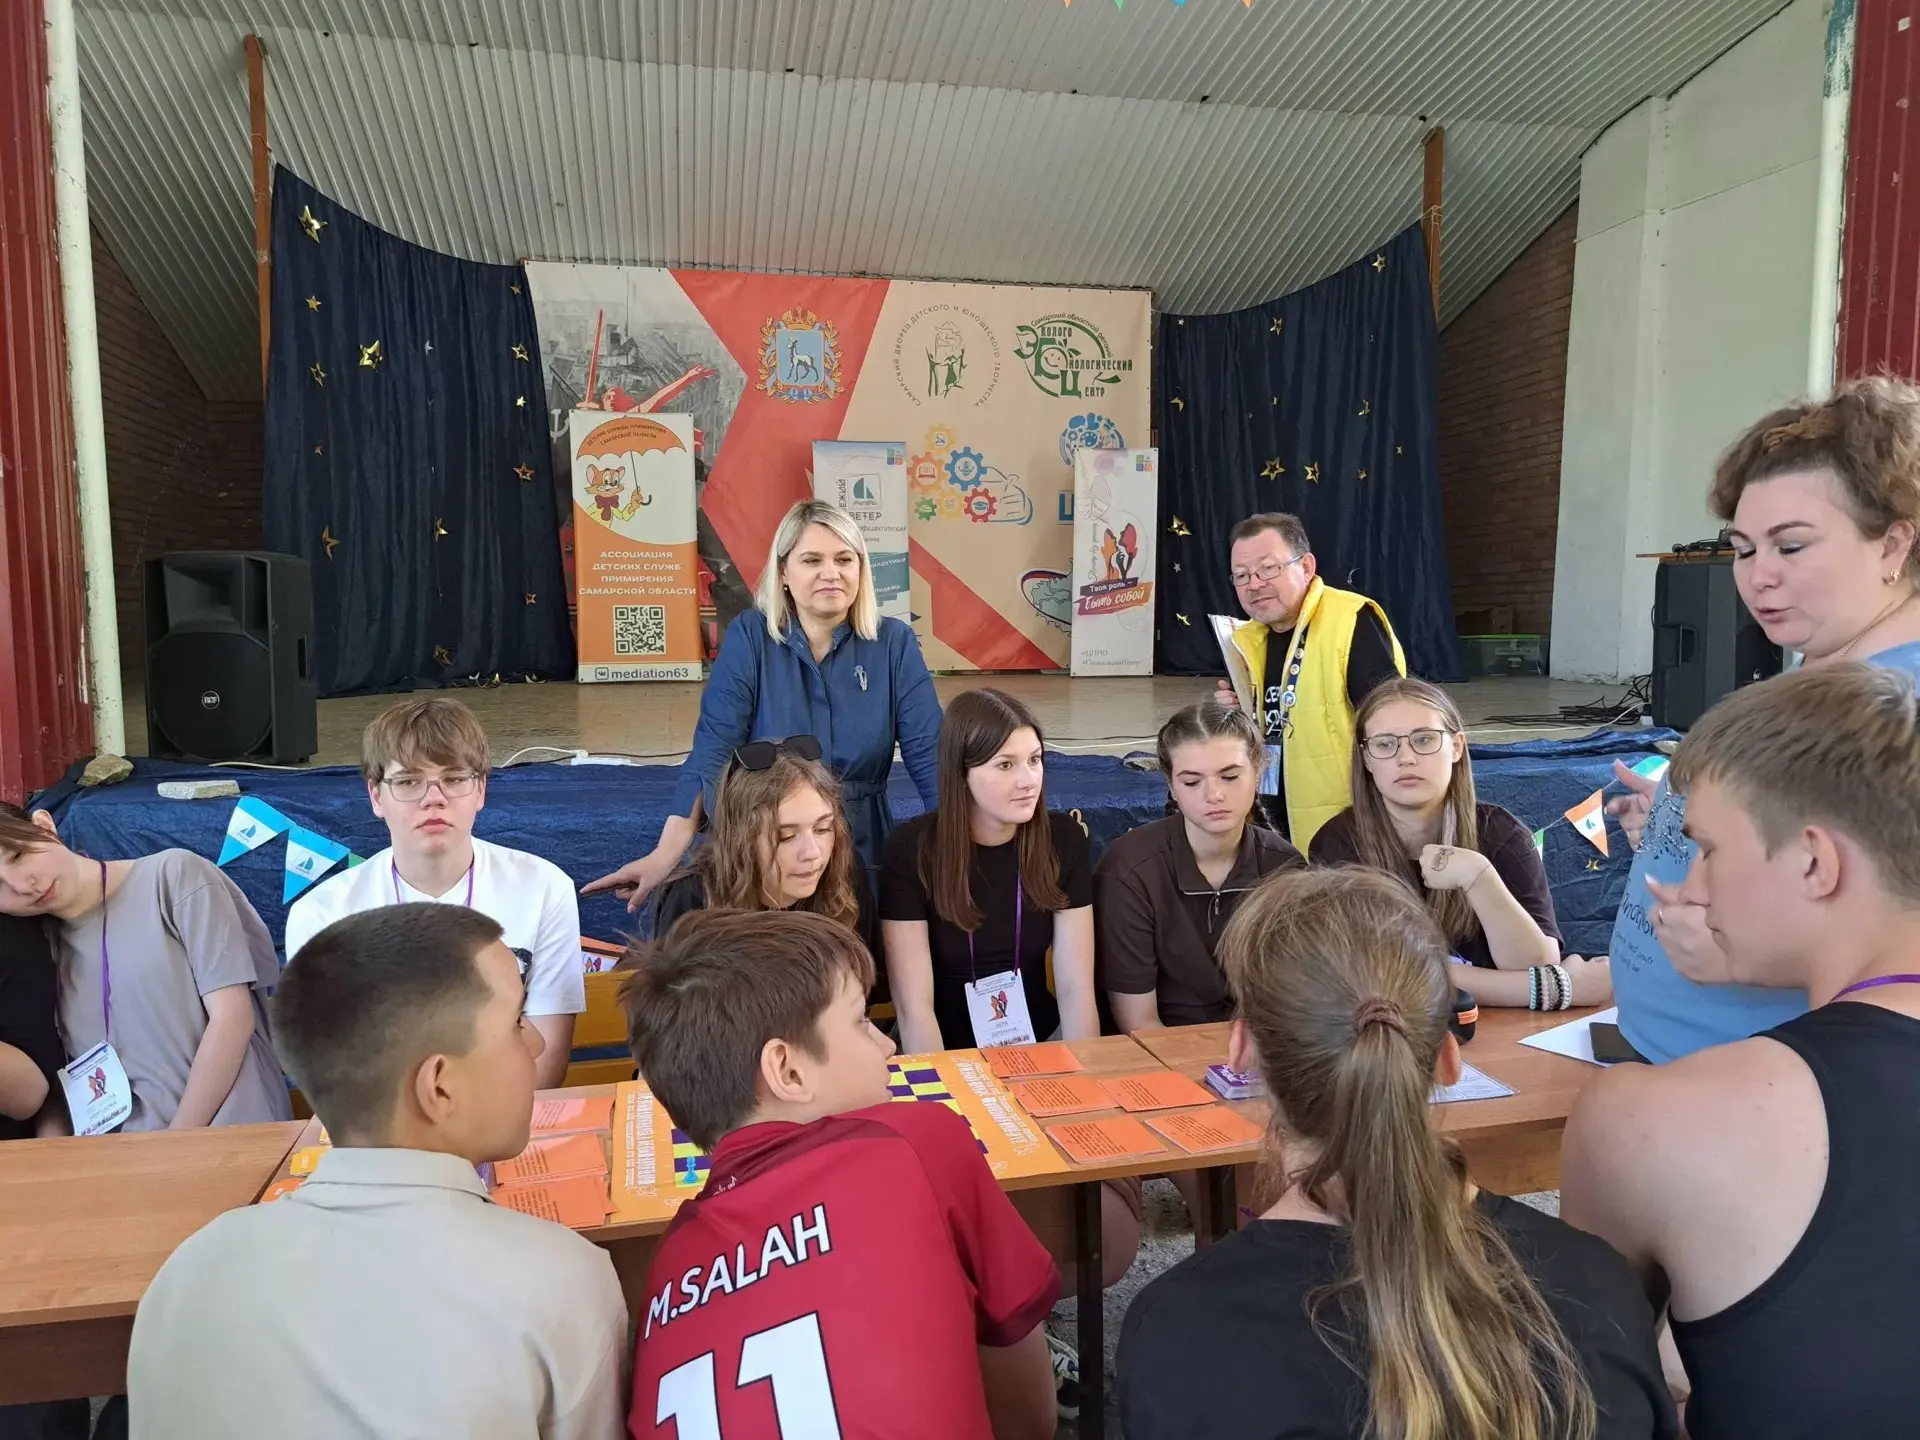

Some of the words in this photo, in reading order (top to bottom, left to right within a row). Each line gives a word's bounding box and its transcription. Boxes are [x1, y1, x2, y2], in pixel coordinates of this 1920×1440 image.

[910, 304, 949, 324] ДЕТСКОГО
[894, 323, 911, 355] ДВОРЕЦ
[962, 308, 1000, 358] ЮНОШЕСКОГО
[893, 358, 921, 406] САМАРСКИЙ
[600, 551, 673, 559] АССОЦИАЦИЯ
[592, 563, 641, 571] ДЕТСКИХ
[643, 563, 682, 571] СЛУЖБ
[578, 586, 645, 595] САМАРСКОЙ
[648, 587, 697, 595] ОБЛАСТИ
[1108, 582, 1126, 591] роль
[611, 668, 689, 679] mediation63
[203, 696, 219, 704] RCF
[644, 1202, 832, 1342] M.SALAH
[655, 1309, 844, 1440] 11
